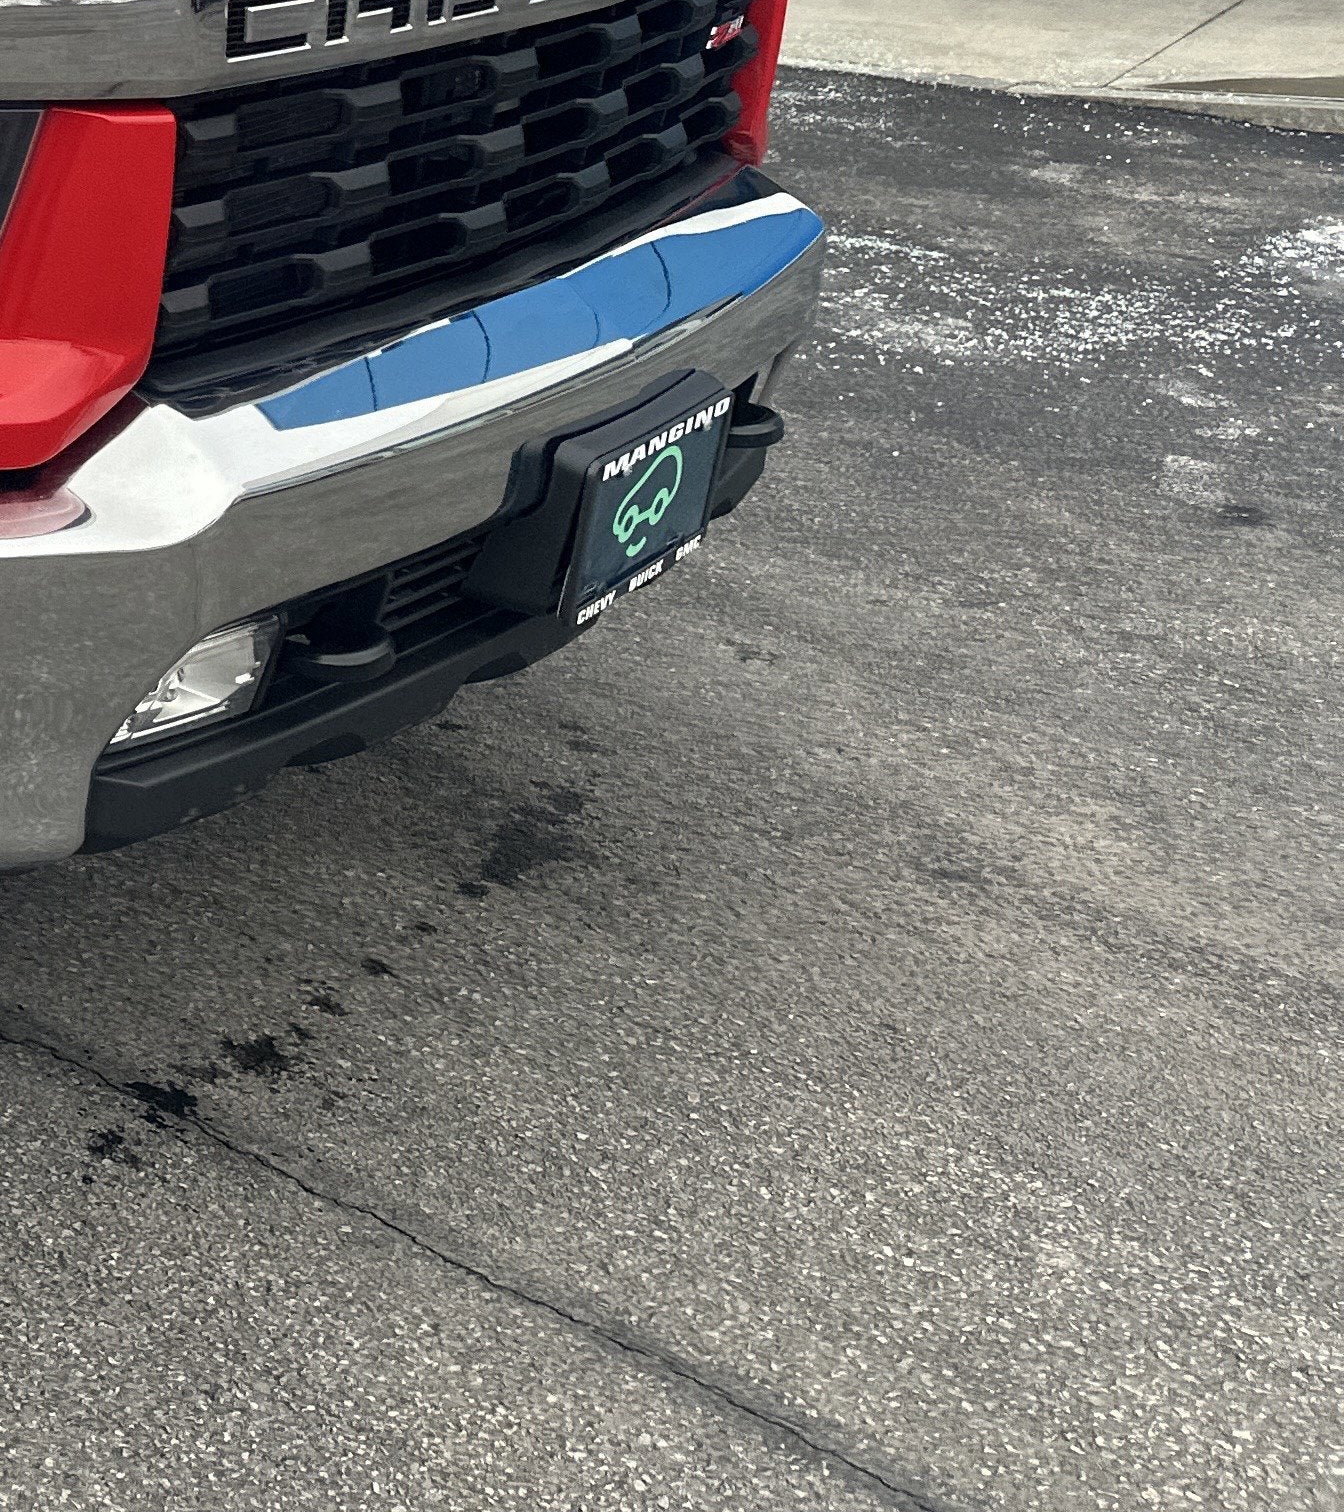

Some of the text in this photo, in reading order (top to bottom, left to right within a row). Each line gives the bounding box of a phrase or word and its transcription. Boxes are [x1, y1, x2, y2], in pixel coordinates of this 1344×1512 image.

[602, 396, 732, 482] MANGINO
[576, 534, 701, 624] CHEVY BUICK GMC
